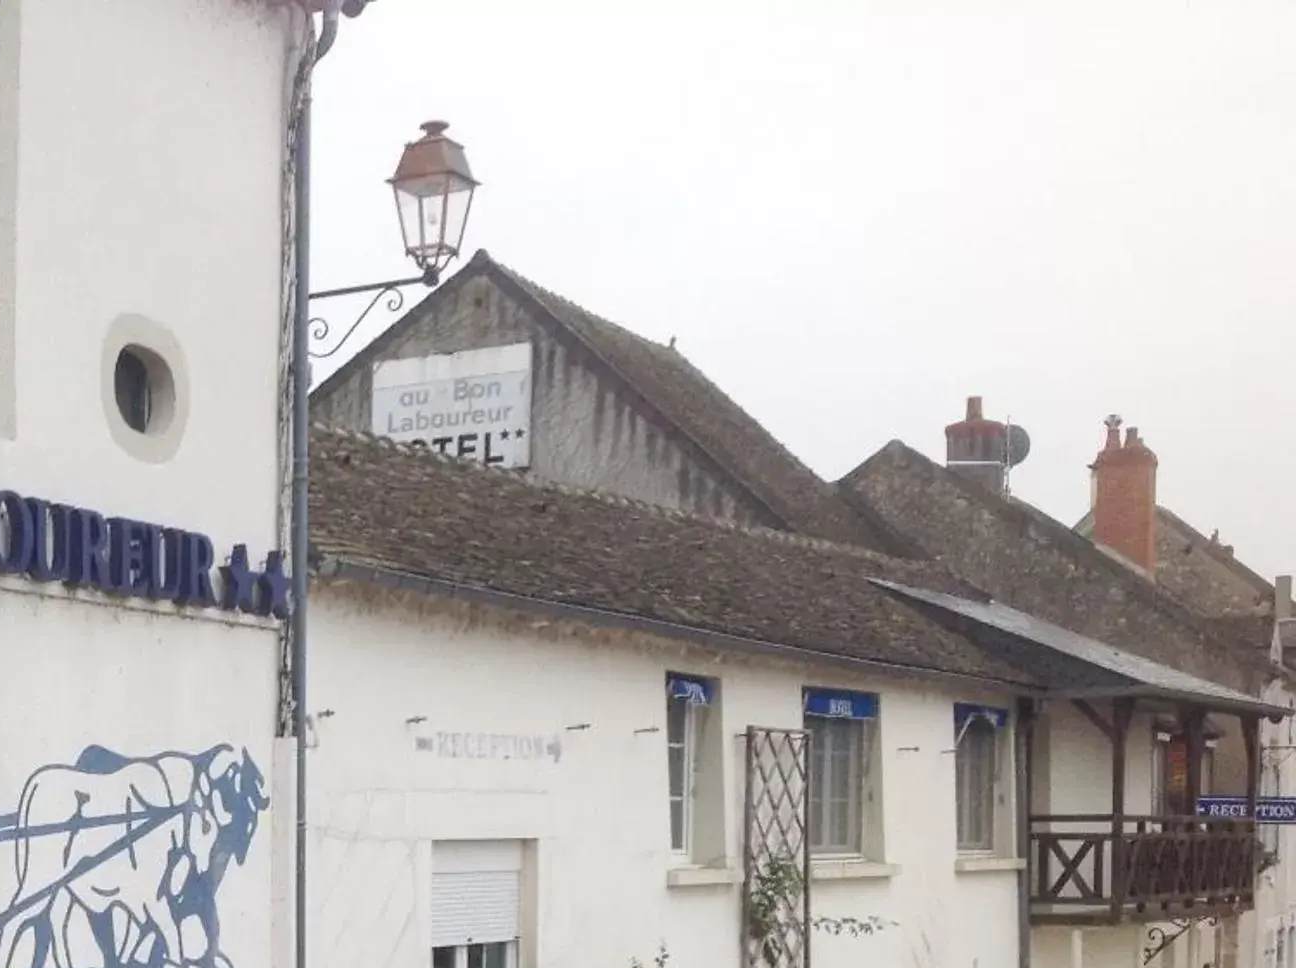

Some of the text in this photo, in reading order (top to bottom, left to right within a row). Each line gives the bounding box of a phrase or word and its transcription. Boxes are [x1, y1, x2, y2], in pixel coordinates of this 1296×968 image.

[399, 379, 502, 407] au Bon
[387, 404, 513, 434] Laboureur
[1209, 804, 1296, 817] RECETION
